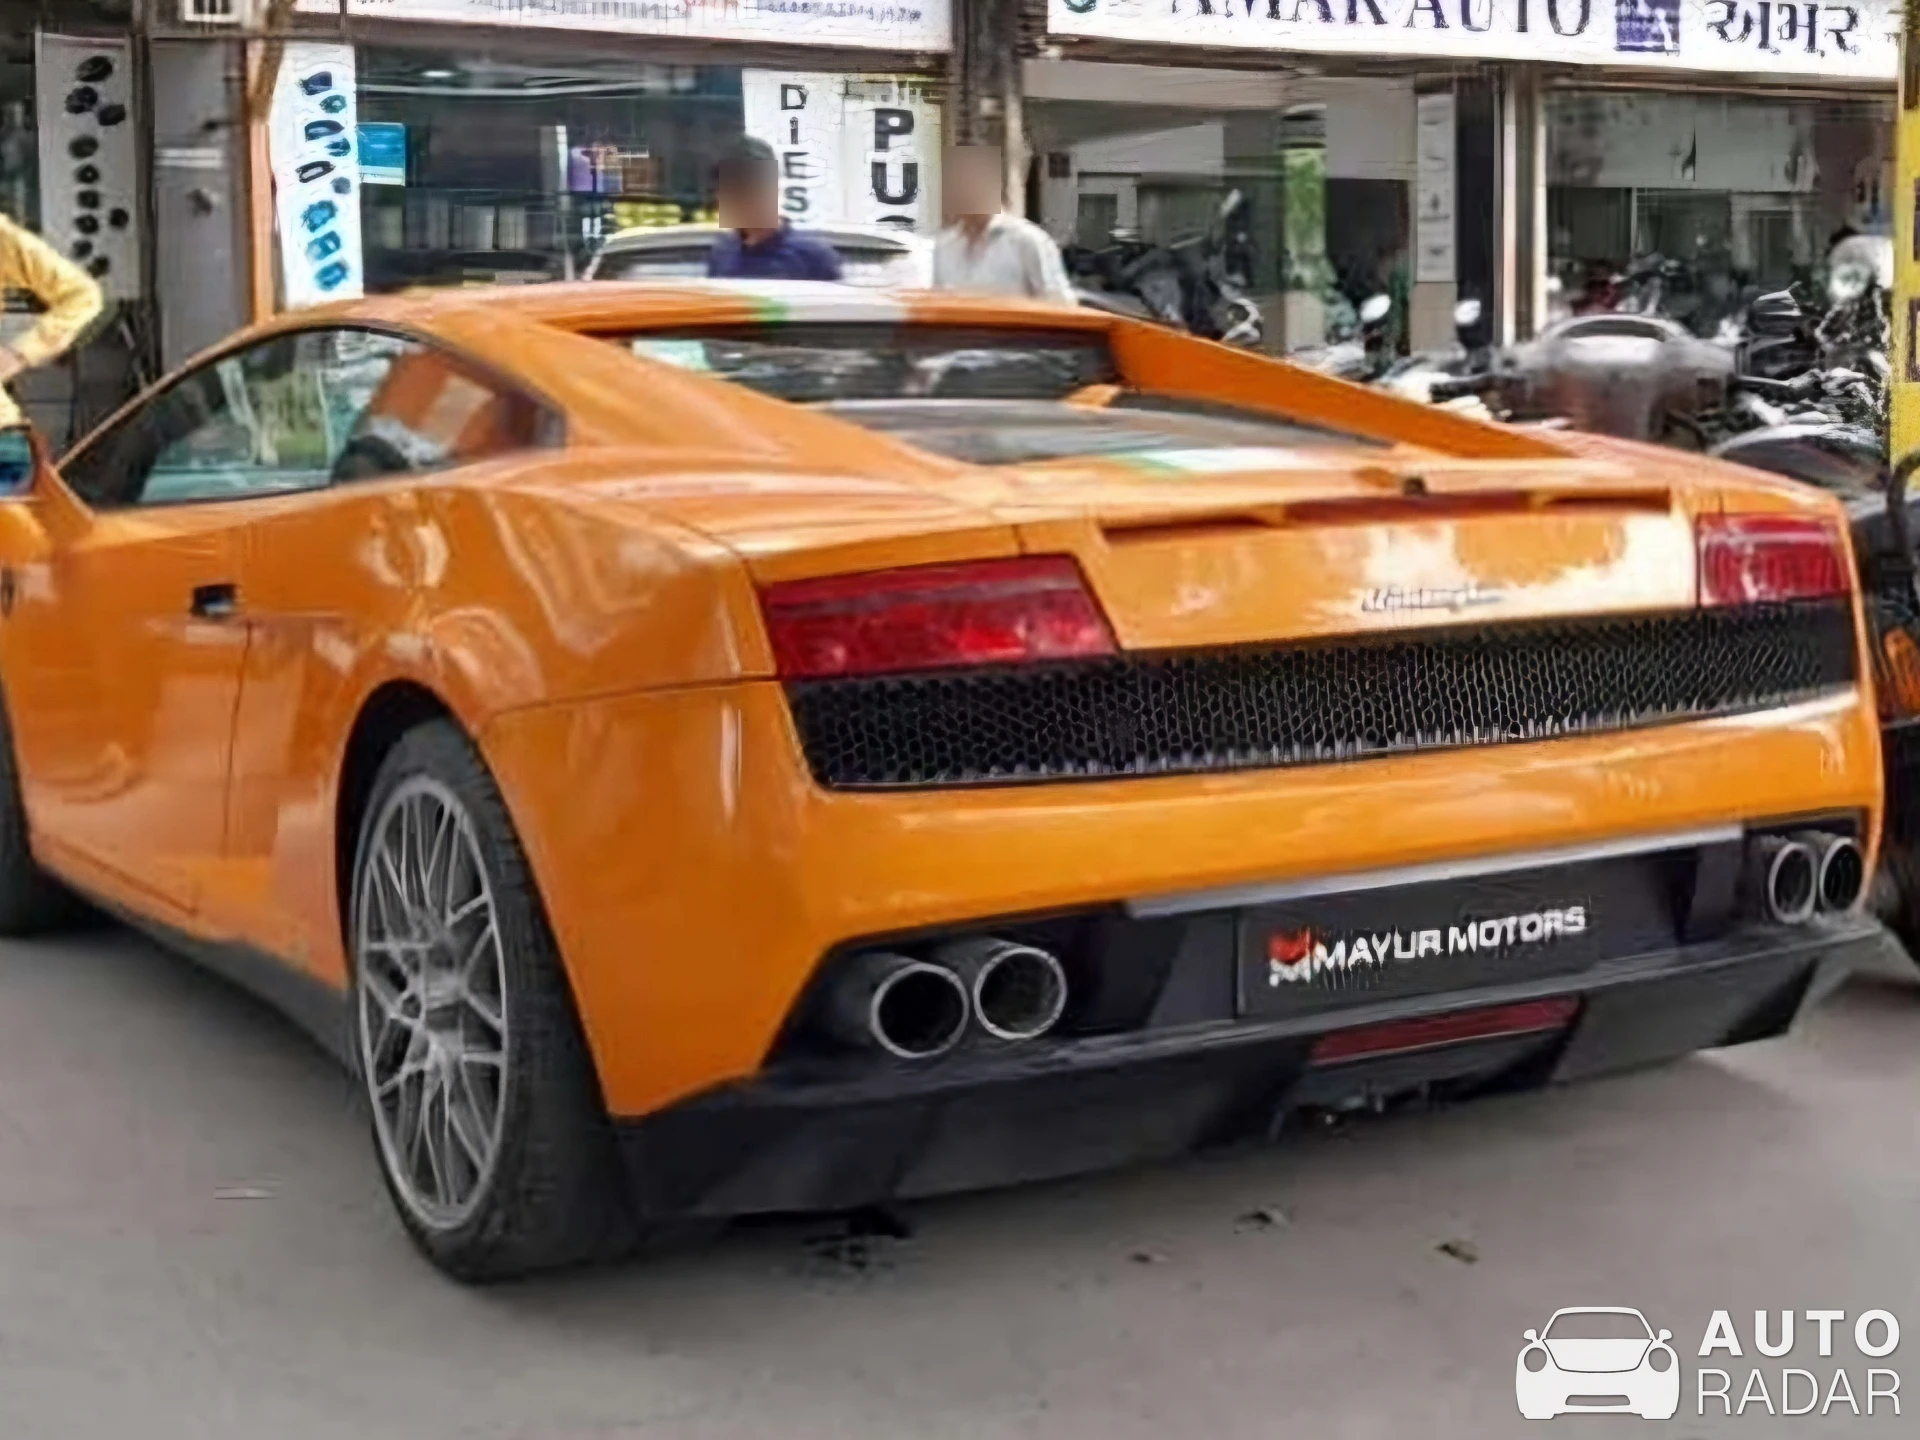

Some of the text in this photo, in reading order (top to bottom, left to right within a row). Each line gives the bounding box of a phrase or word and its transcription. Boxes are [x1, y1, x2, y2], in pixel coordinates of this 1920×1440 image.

[1171, 0, 1389, 25] AR
[780, 83, 811, 222] DIES
[871, 108, 919, 232] PU
[1448, 905, 1587, 957] MOTORS
